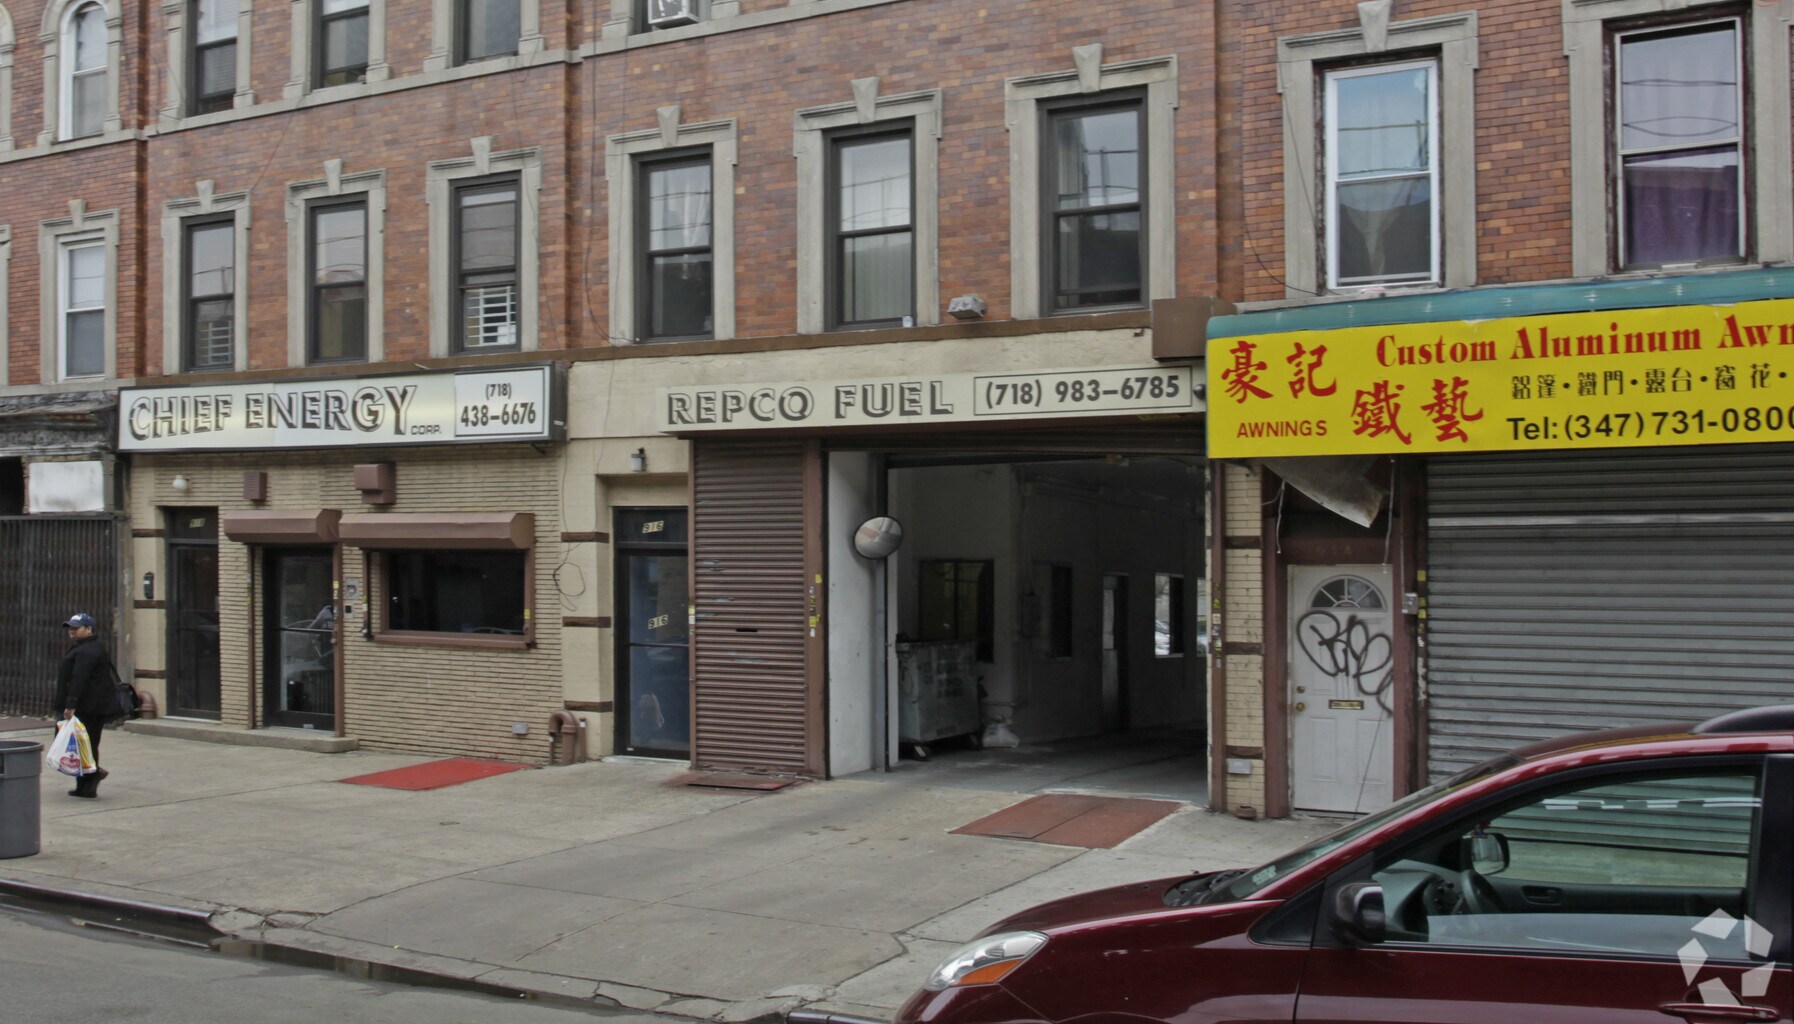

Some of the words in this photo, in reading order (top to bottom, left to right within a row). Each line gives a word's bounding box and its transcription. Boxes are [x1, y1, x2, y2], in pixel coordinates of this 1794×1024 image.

[1376, 334, 1497, 367] Custom
[1509, 323, 1702, 360] Aluminum
[1220, 340, 1338, 404] 豪記
[485, 383, 512, 400] (718)
[667, 385, 814, 425] REPCO
[833, 380, 953, 419] FUEL
[985, 378, 1042, 408] (718)
[1055, 375, 1180, 403] 983-6785
[129, 393, 233, 441] CHIEF
[245, 384, 417, 436] ENERGY
[410, 425, 442, 435] CORP.
[460, 402, 536, 427] 438-6676
[1236, 419, 1328, 438] AWNINGS
[649, 616, 667, 628] 916
